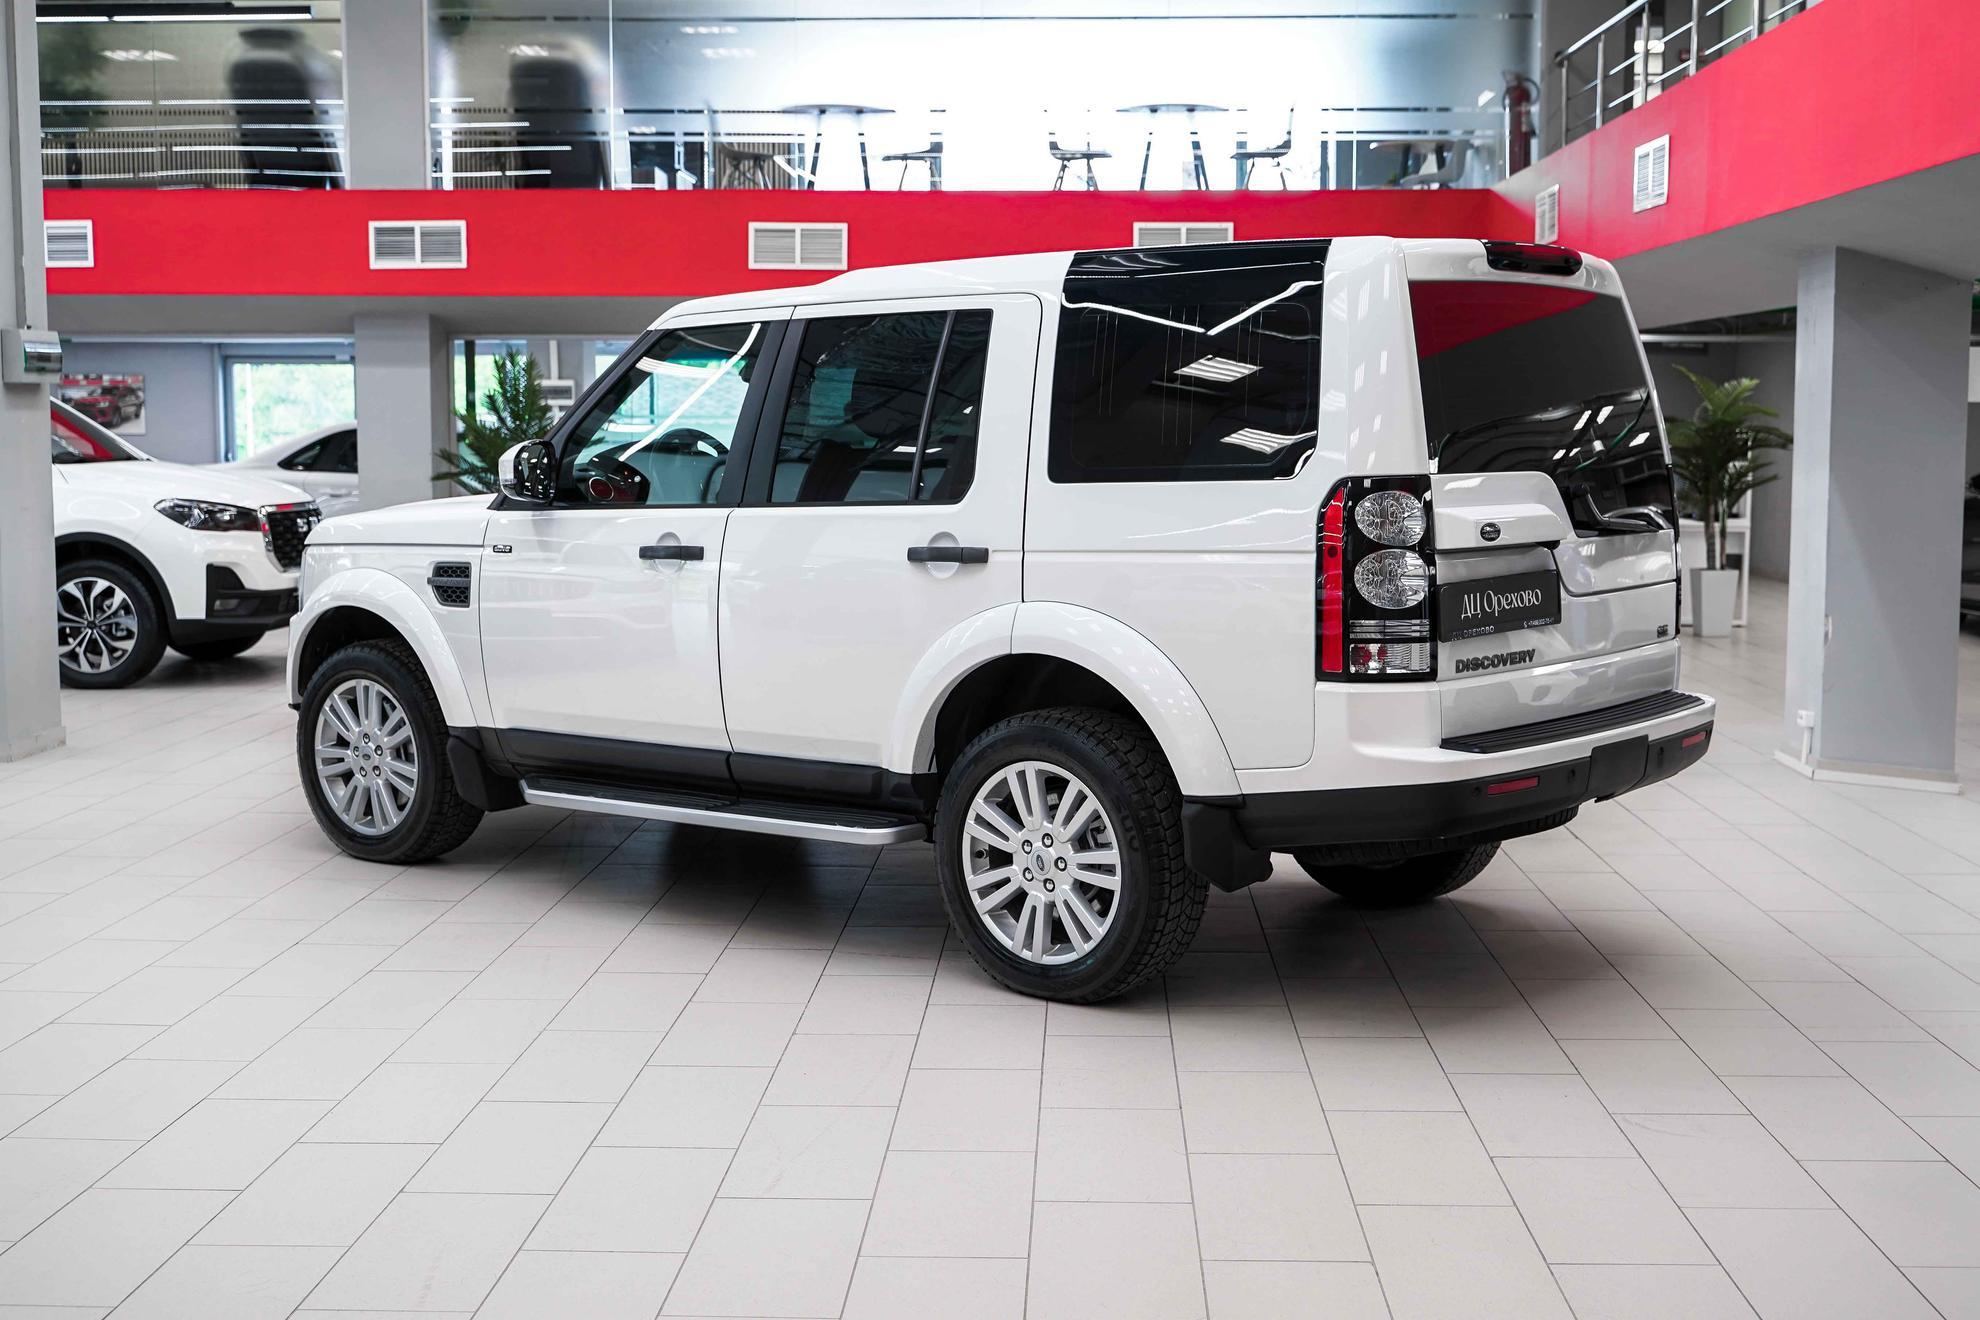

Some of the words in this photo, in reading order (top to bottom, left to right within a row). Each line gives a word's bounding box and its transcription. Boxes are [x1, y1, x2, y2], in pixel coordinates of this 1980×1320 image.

[1461, 592, 1481, 620] ДЦ
[1484, 588, 1541, 616] Орехово
[1455, 648, 1536, 674] DISCOVERY
